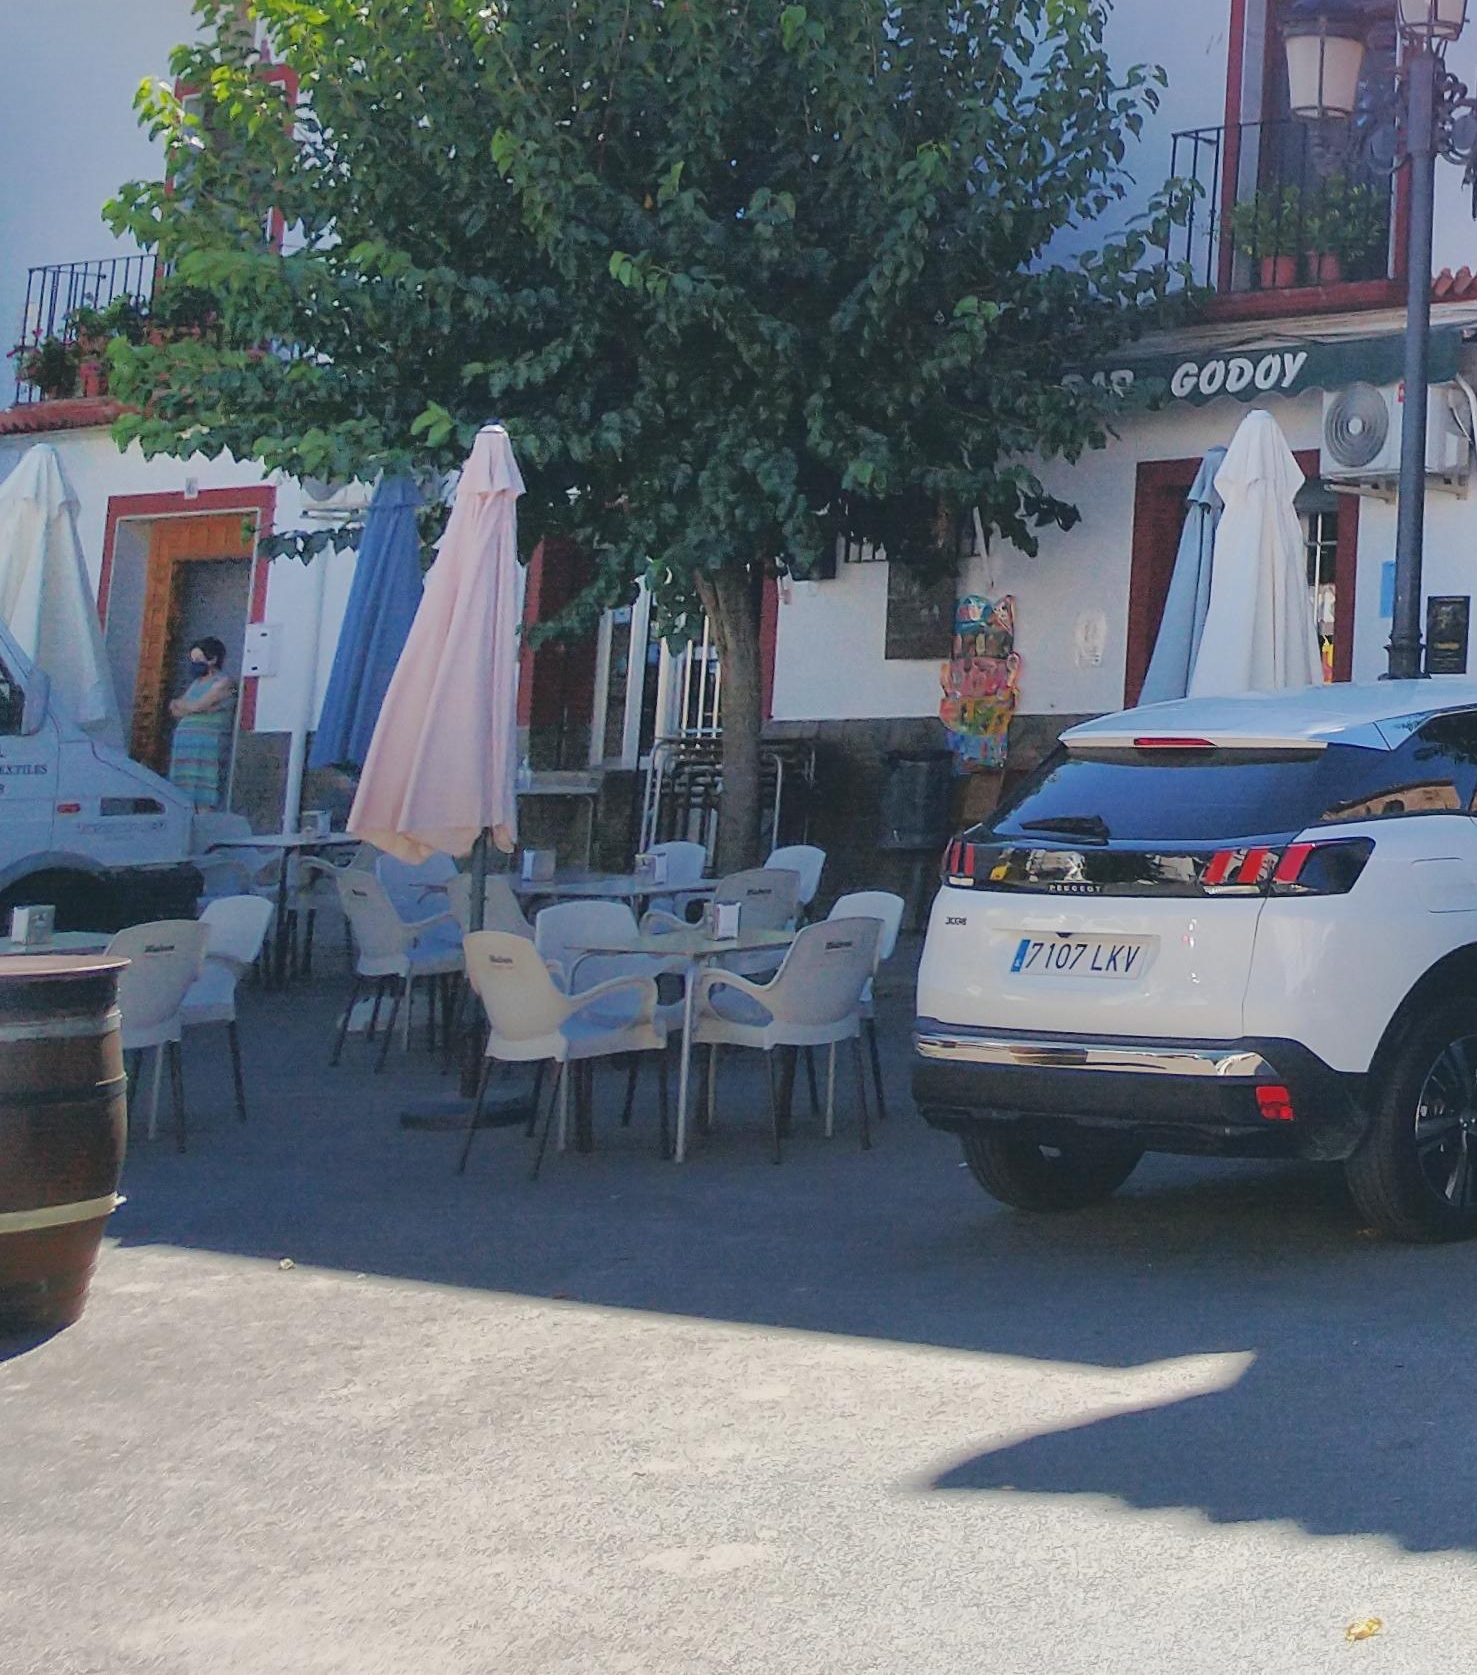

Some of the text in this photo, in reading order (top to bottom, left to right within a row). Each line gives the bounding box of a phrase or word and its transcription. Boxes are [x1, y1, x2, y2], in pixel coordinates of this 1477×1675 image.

[1171, 351, 1308, 398] GODOY
[1049, 884, 1101, 893] PEUGEOT
[1024, 942, 1141, 973] 7107 LKV
